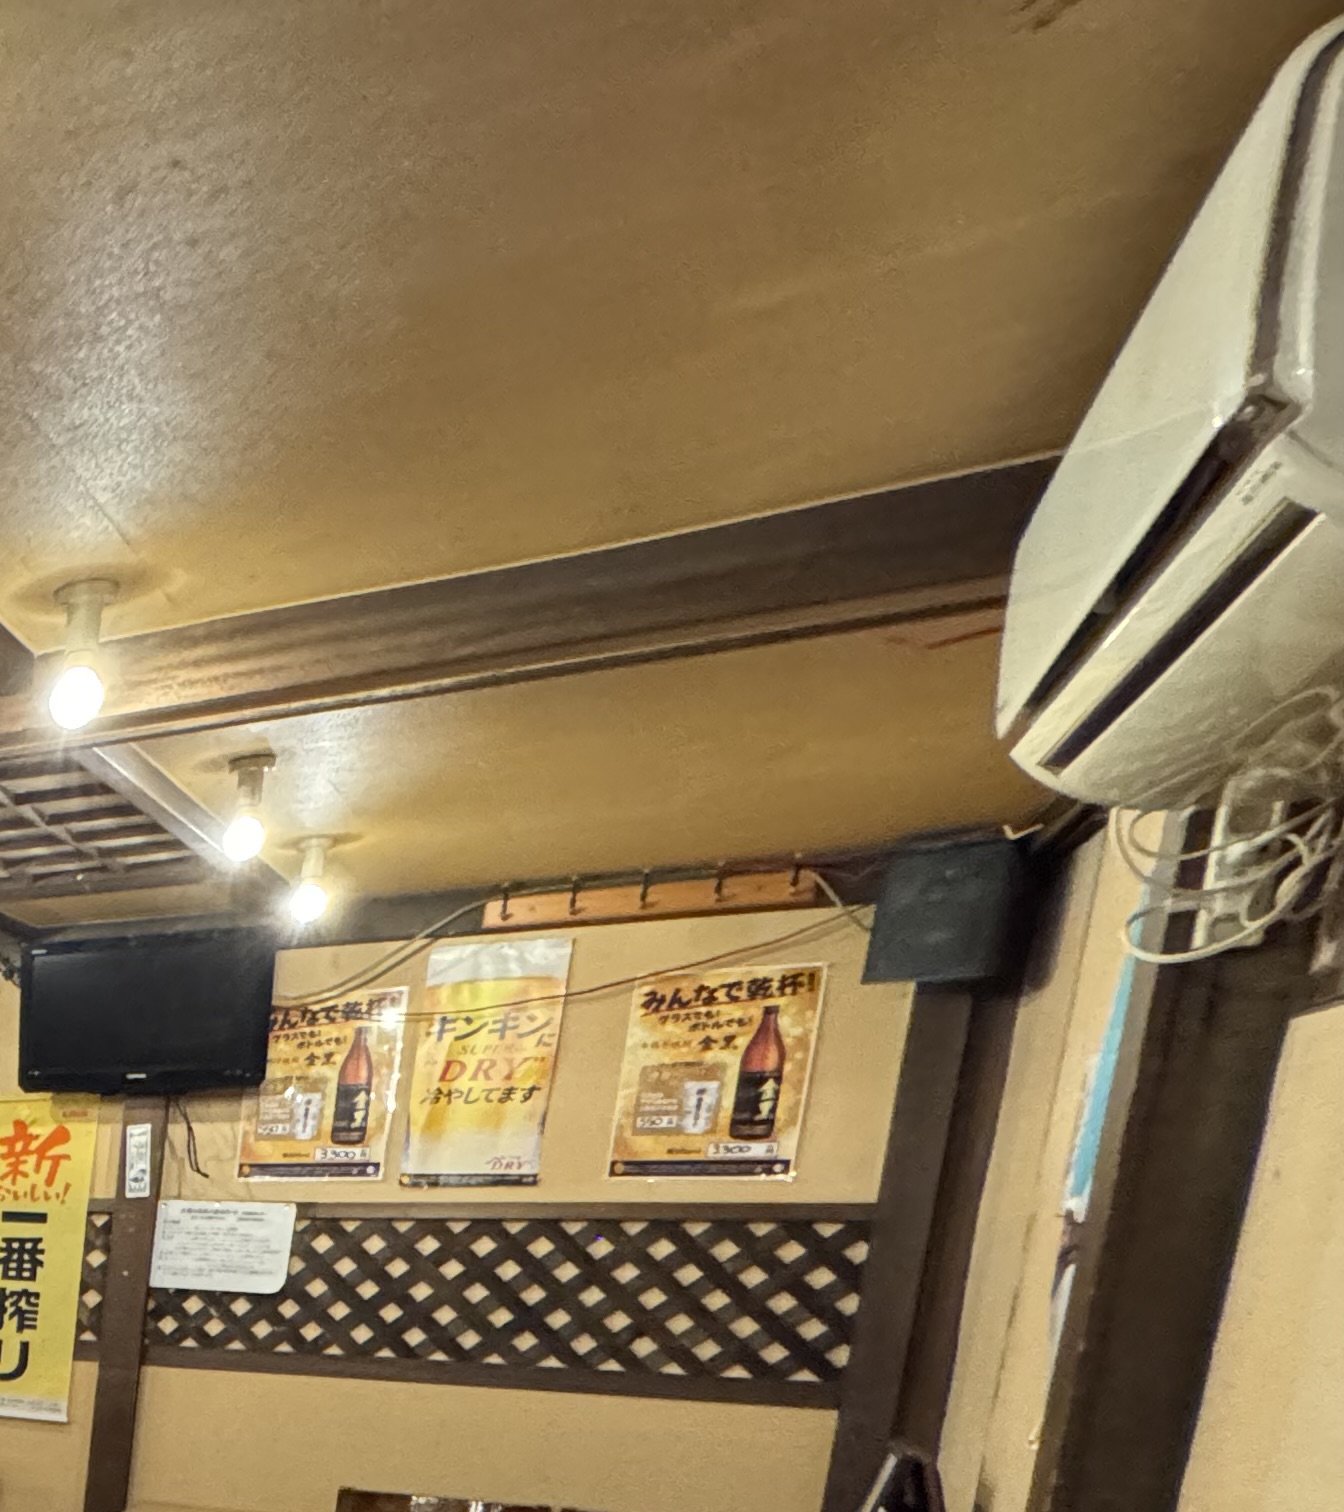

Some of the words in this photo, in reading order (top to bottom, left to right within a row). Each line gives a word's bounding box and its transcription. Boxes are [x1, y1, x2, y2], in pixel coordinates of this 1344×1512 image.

[640, 973, 816, 1011] みんなで乾杯!
